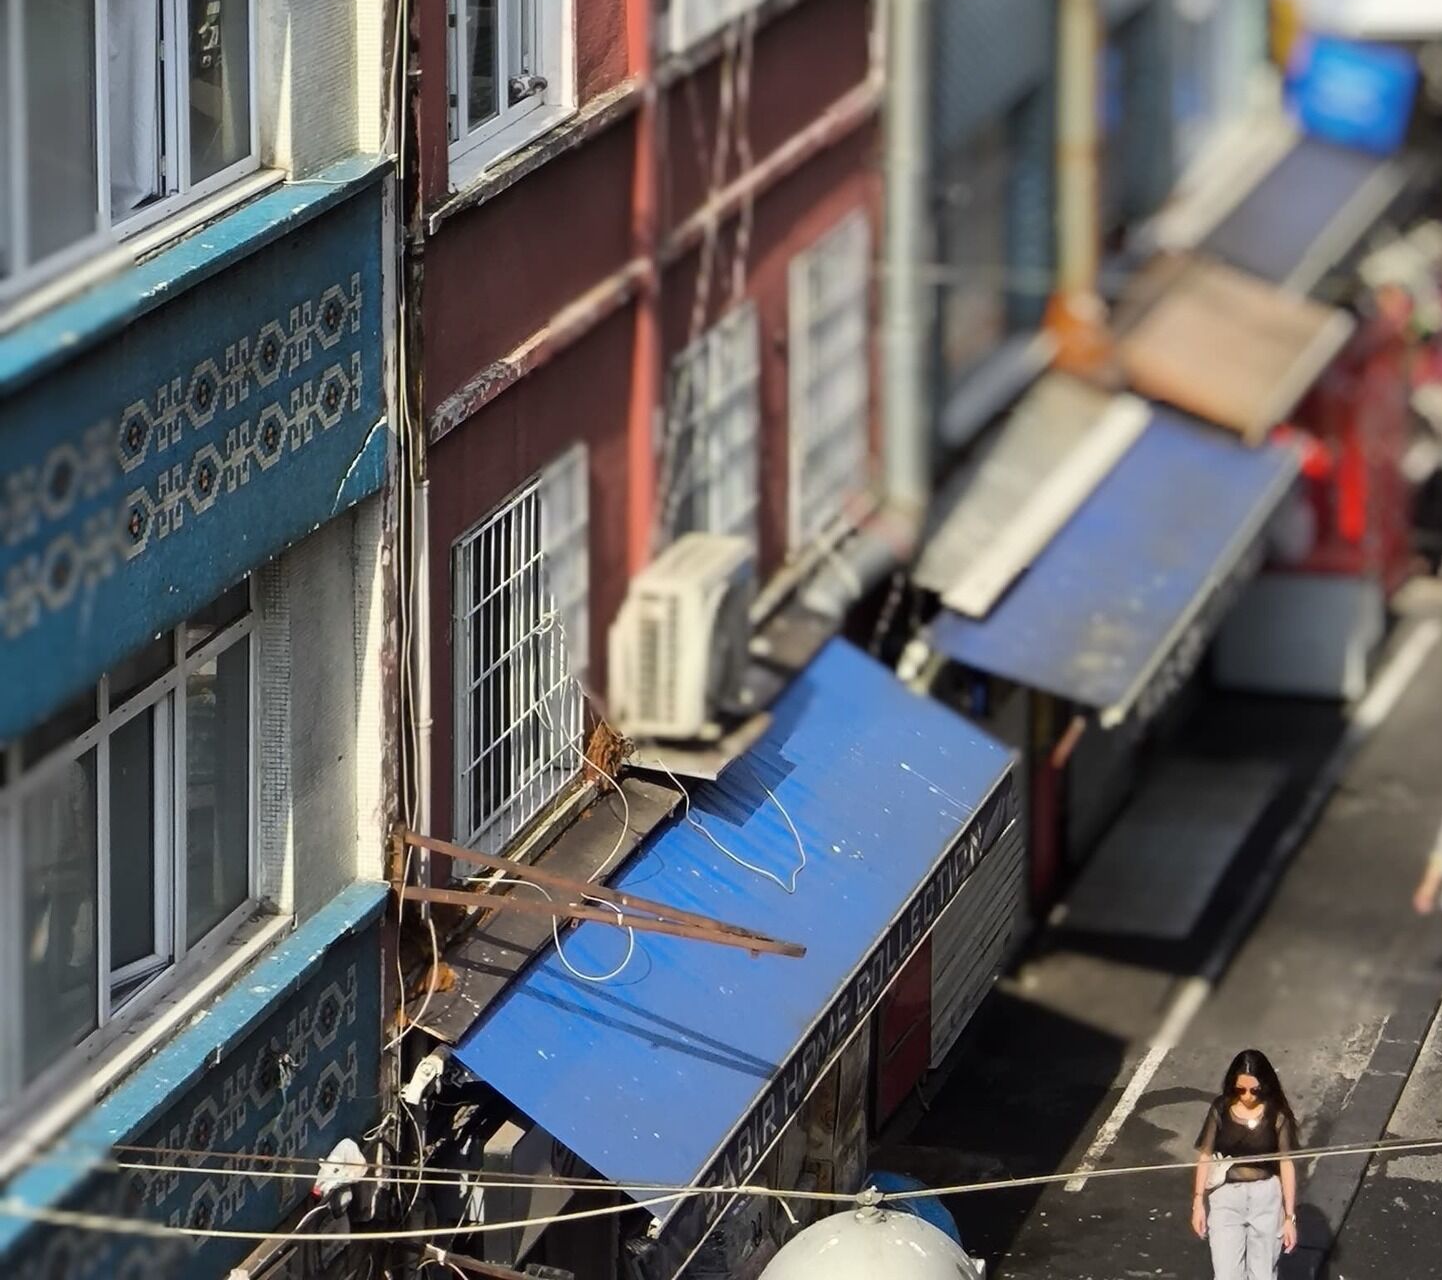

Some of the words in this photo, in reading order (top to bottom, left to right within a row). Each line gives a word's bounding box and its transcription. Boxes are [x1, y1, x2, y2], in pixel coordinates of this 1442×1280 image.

[704, 1093, 777, 1224] SABIR
[783, 993, 849, 1116] HOME
[856, 822, 984, 1016] COLLECTION
